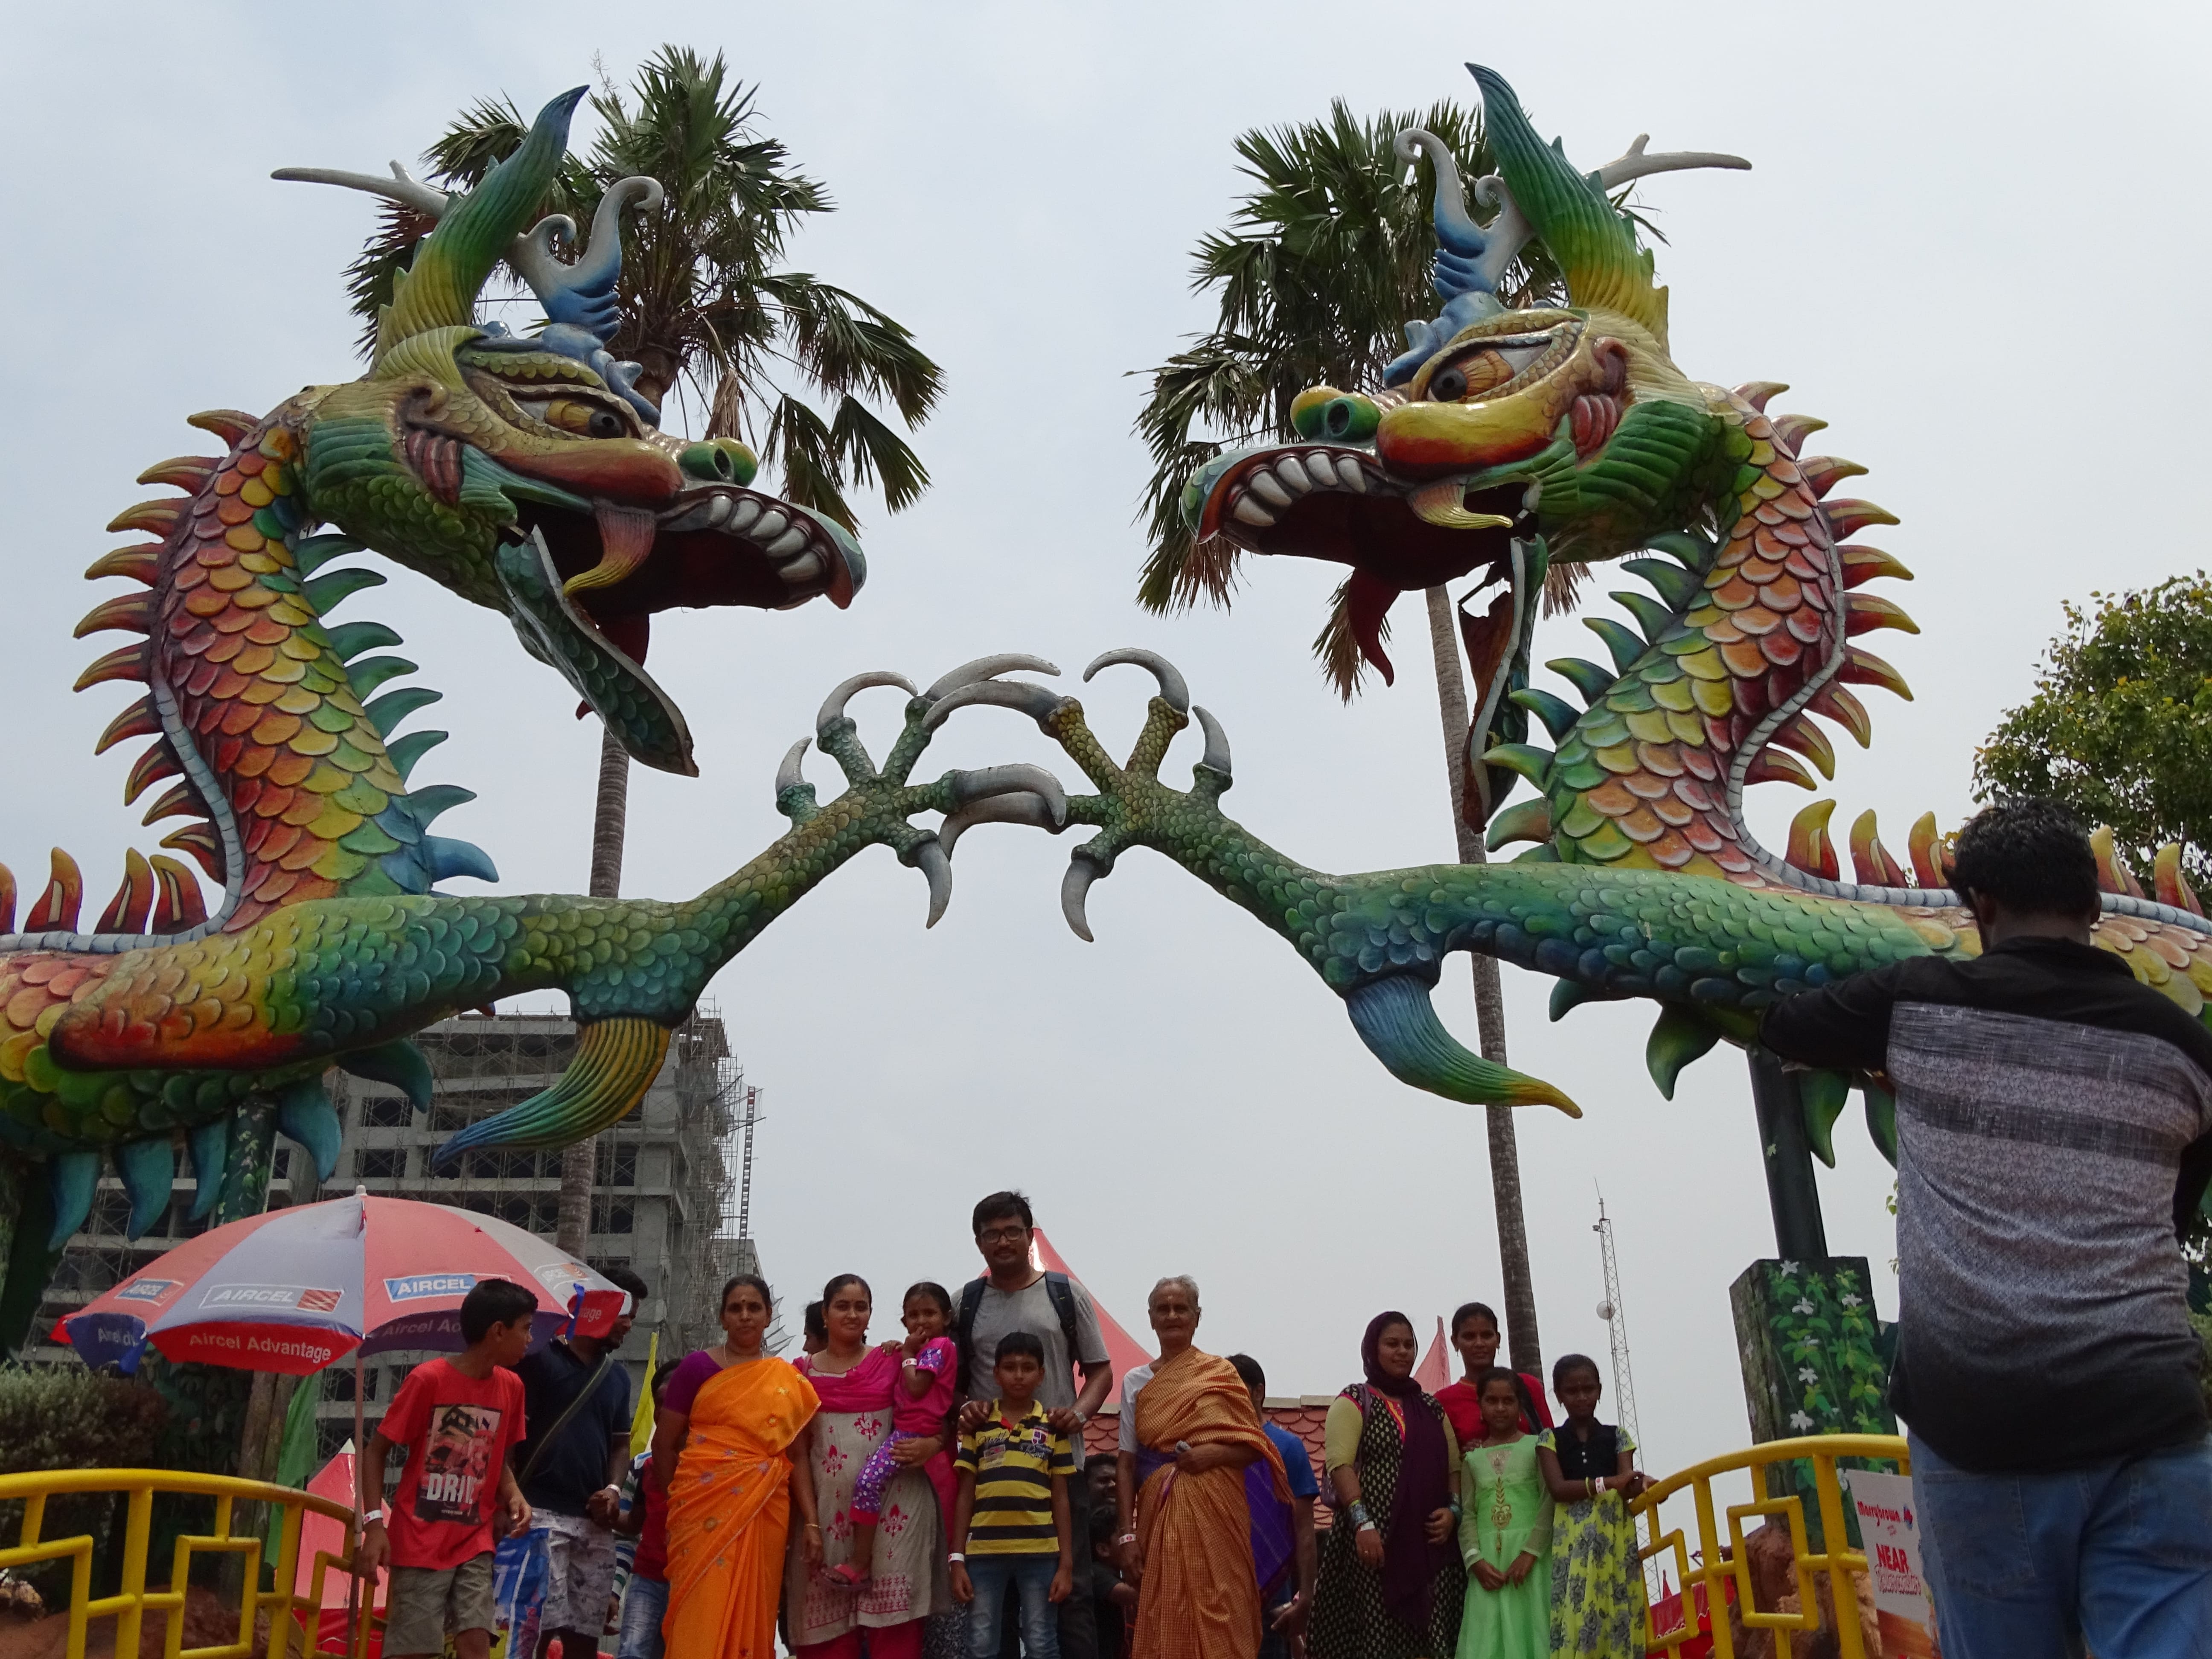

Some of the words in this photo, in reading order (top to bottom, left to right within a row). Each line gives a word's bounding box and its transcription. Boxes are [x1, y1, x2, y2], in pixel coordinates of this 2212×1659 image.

[212, 1289, 294, 1302] AIRCEL
[397, 1278, 471, 1295] AIRCEL
[382, 1319, 434, 1337] Aircel
[189, 1333, 240, 1349] Aircel
[247, 1336, 331, 1364] Advantage
[1876, 1543, 1910, 1575] NEAR
